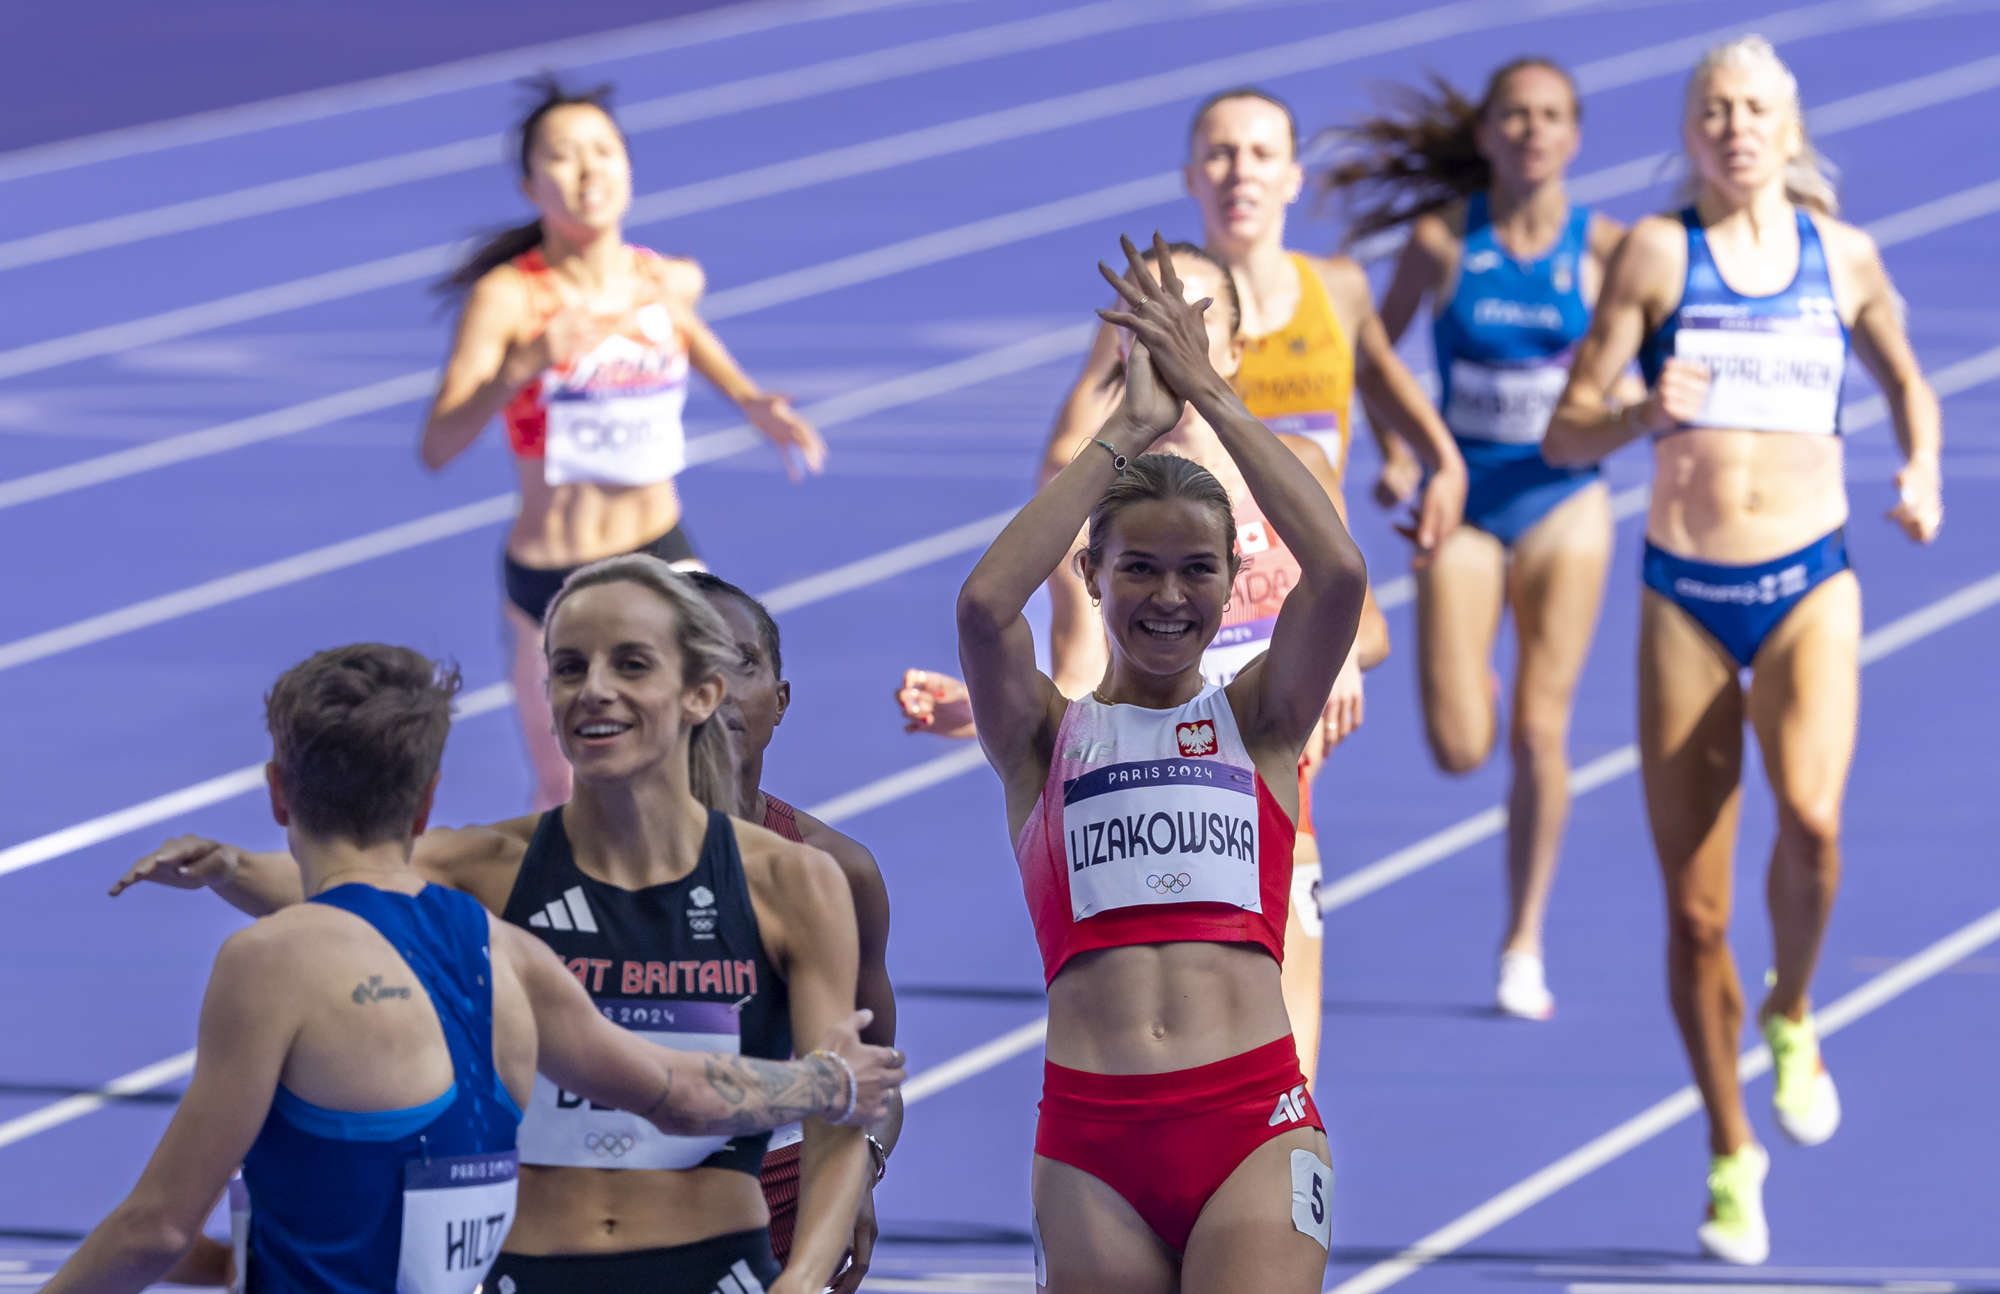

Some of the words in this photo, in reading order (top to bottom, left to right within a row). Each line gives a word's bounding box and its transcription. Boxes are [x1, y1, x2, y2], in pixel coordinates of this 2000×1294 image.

[1108, 766, 1160, 785] PARIS
[1167, 764, 1213, 780] 2024
[1070, 810, 1255, 873] LIZAKOWSKA
[621, 959, 758, 995] BRITAIN
[620, 1006, 675, 1025] 2024
[1310, 1172, 1325, 1225] 5
